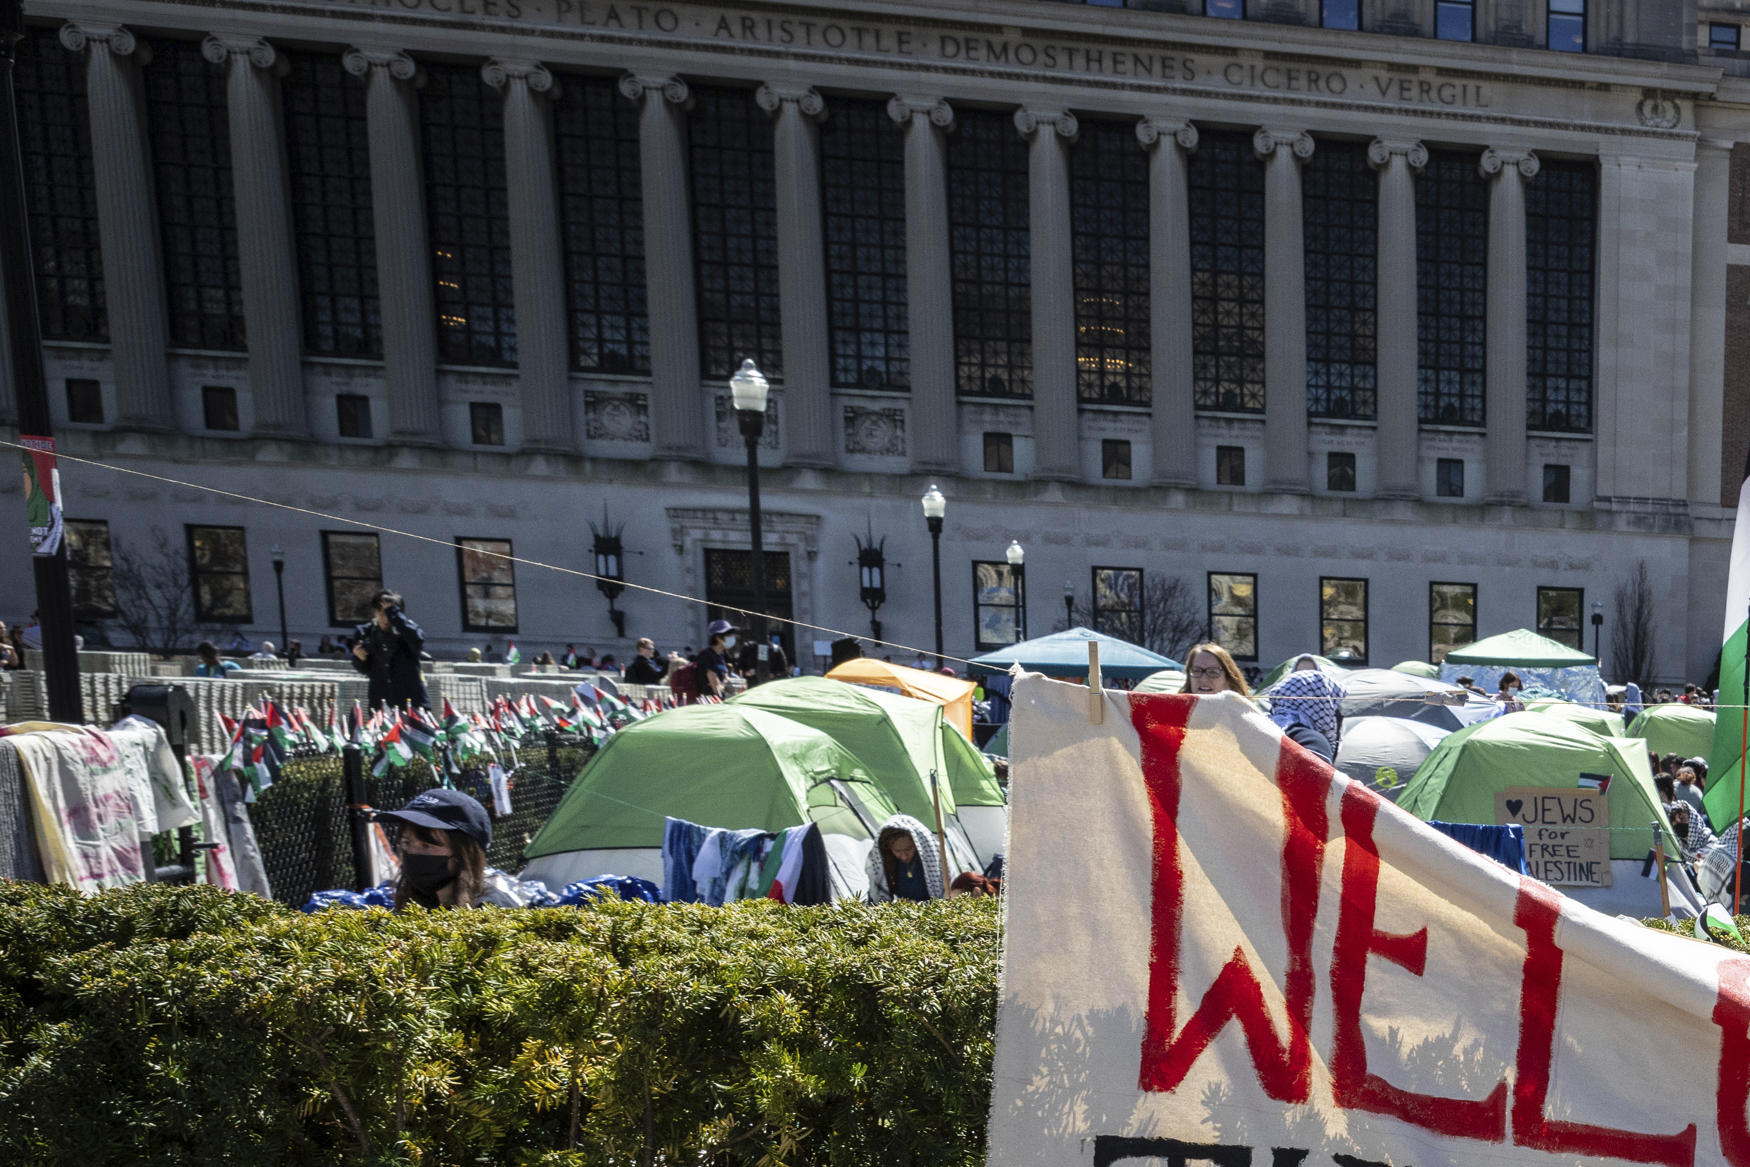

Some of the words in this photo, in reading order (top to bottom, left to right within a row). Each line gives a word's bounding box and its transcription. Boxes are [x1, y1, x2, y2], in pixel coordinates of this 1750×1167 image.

[555, 3, 679, 33] PLATO
[713, 14, 913, 54] ARISTOTLE
[939, 34, 1196, 82] DEMOSTHENES
[1223, 62, 1347, 95] CICERO
[1372, 76, 1489, 109] VERGIL
[1522, 796, 1595, 825] JEWS
[1537, 828, 1571, 841] for
[1528, 843, 1581, 859] FREE
[1526, 860, 1601, 884] ALESTINE
